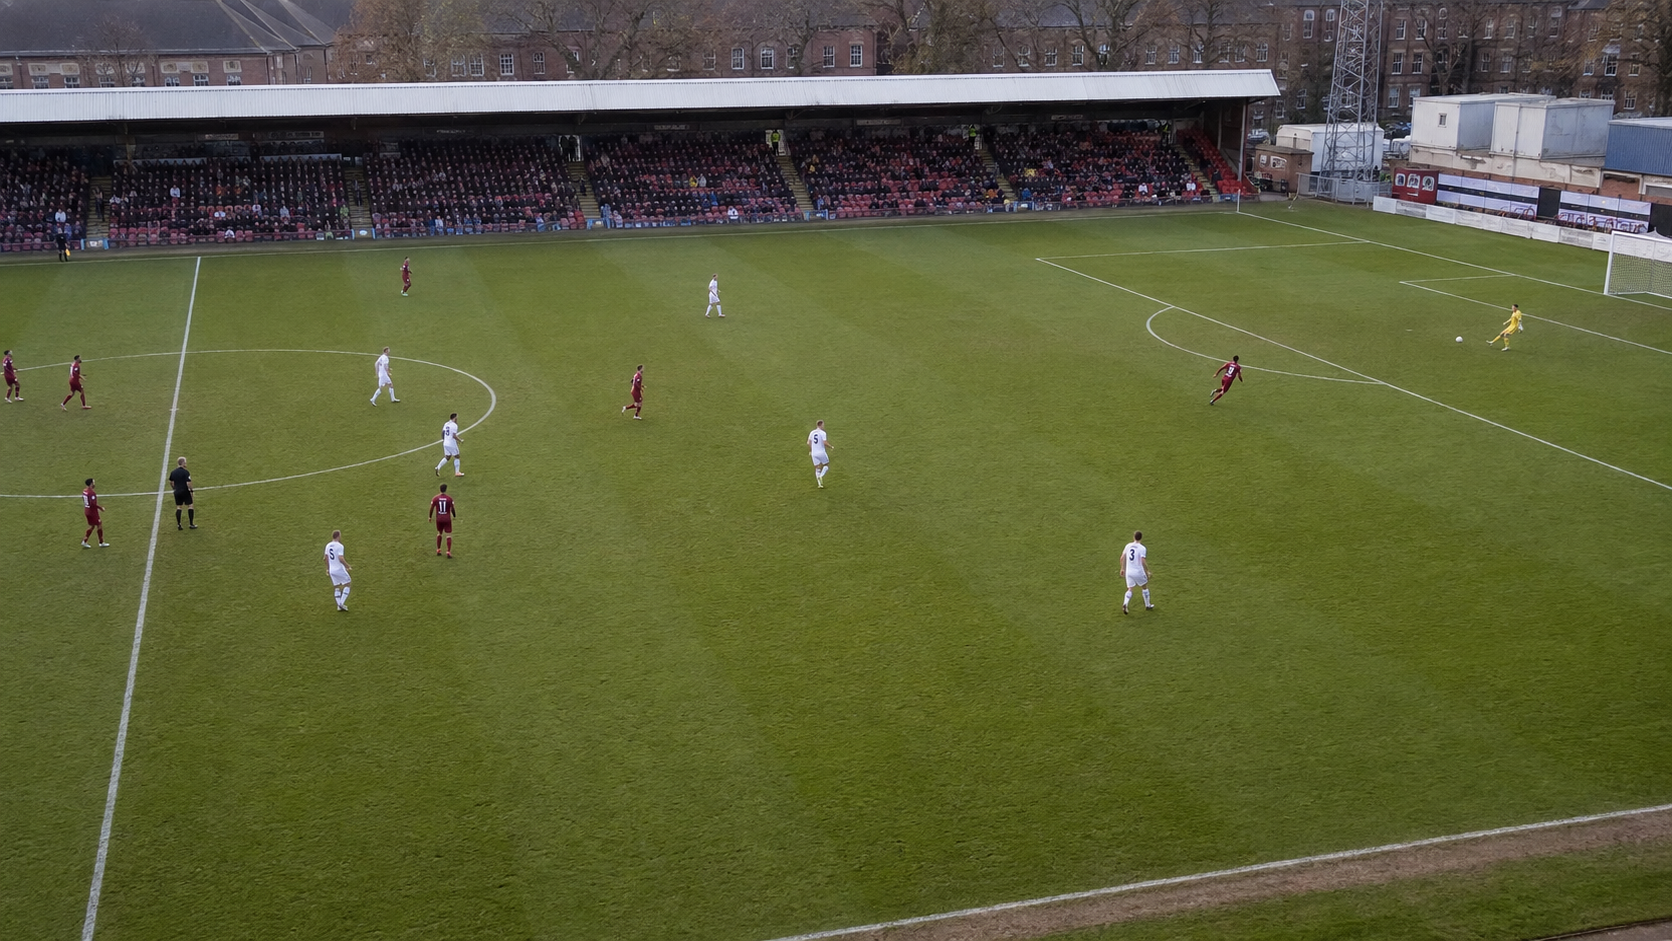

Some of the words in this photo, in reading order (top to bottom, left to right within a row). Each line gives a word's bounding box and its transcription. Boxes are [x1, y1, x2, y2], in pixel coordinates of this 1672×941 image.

[813, 434, 818, 444] 5
[438, 501, 447, 512] 11
[1129, 548, 1135, 561] 3
